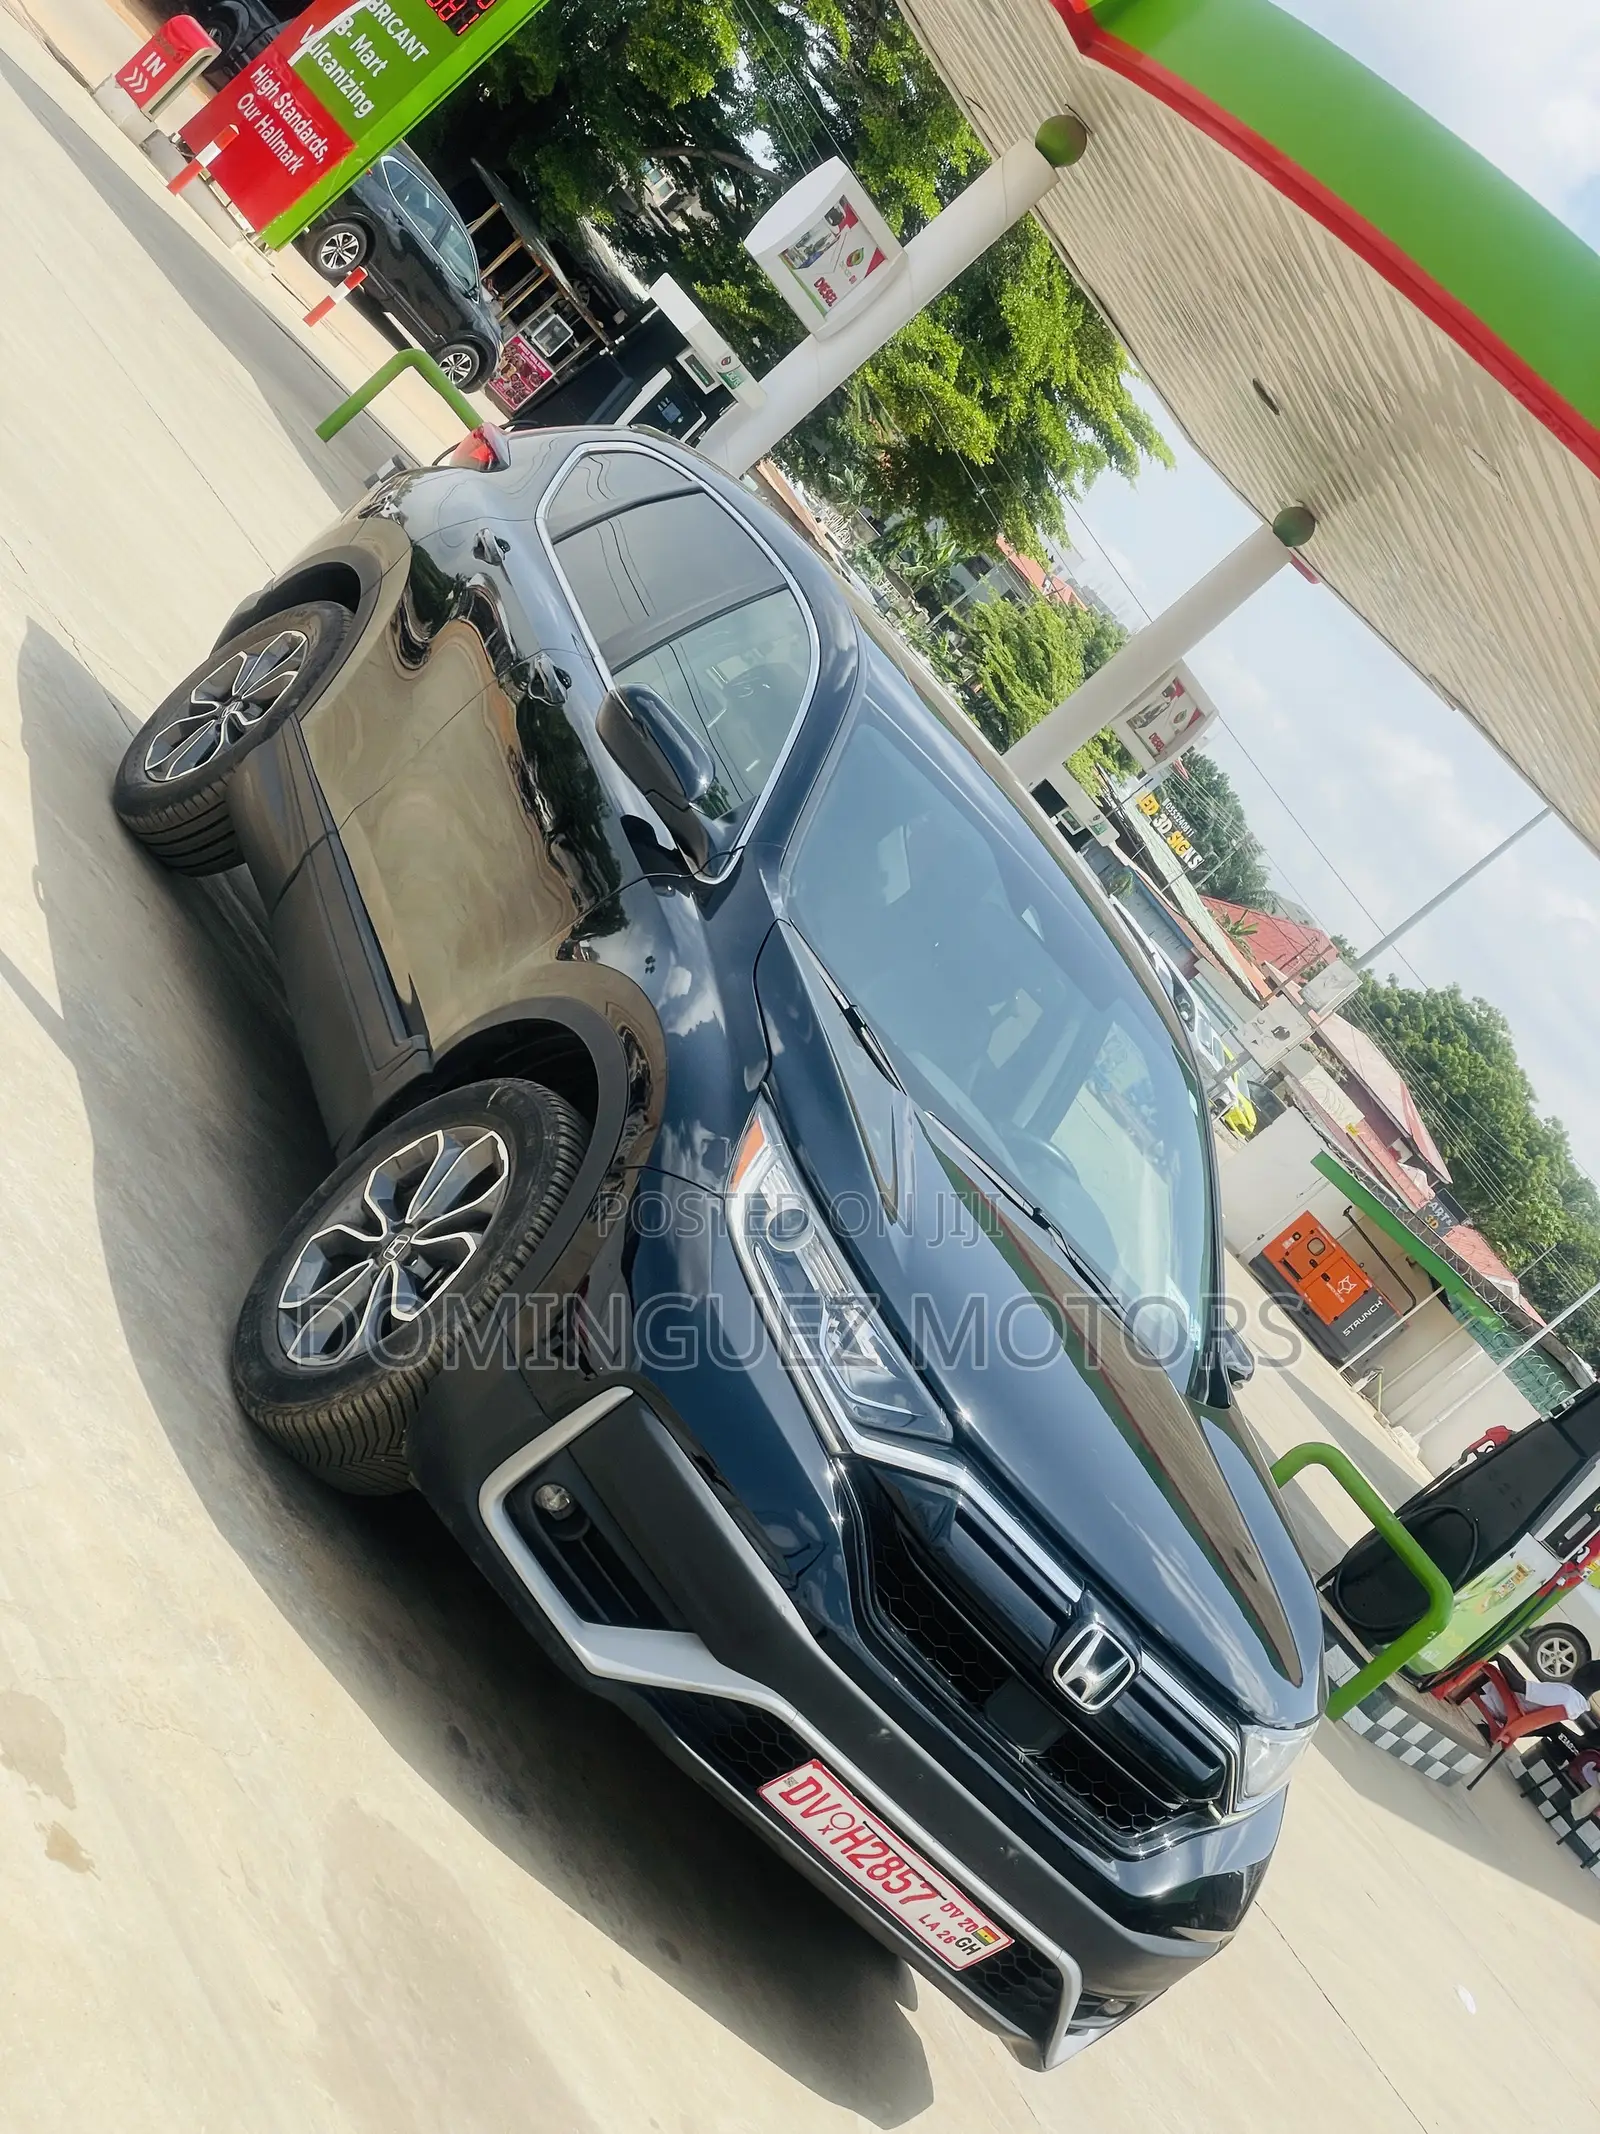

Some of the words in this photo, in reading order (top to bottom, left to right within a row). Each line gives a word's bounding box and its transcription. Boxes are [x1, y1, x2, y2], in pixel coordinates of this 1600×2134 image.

[141, 51, 167, 78] IN
[299, 24, 375, 119] Vulcanizing
[349, 32, 389, 78] Mart
[237, 92, 262, 122] Our
[256, 113, 304, 175] Hallmark
[250, 63, 277, 101] High
[273, 92, 329, 164] Standards,
[814, 276, 838, 307] DIESEL
[1152, 813, 1173, 834] 3D
[1166, 830, 1205, 870] SIGNS
[1425, 1214, 1439, 1229] 3D
[1343, 1299, 1384, 1337] STAUNCH
[778, 1776, 843, 1819] DV
[829, 1825, 940, 1905] H2857
[939, 1901, 964, 1924] DV
[961, 1917, 979, 1933] 20
[954, 1936, 982, 1957] GH
